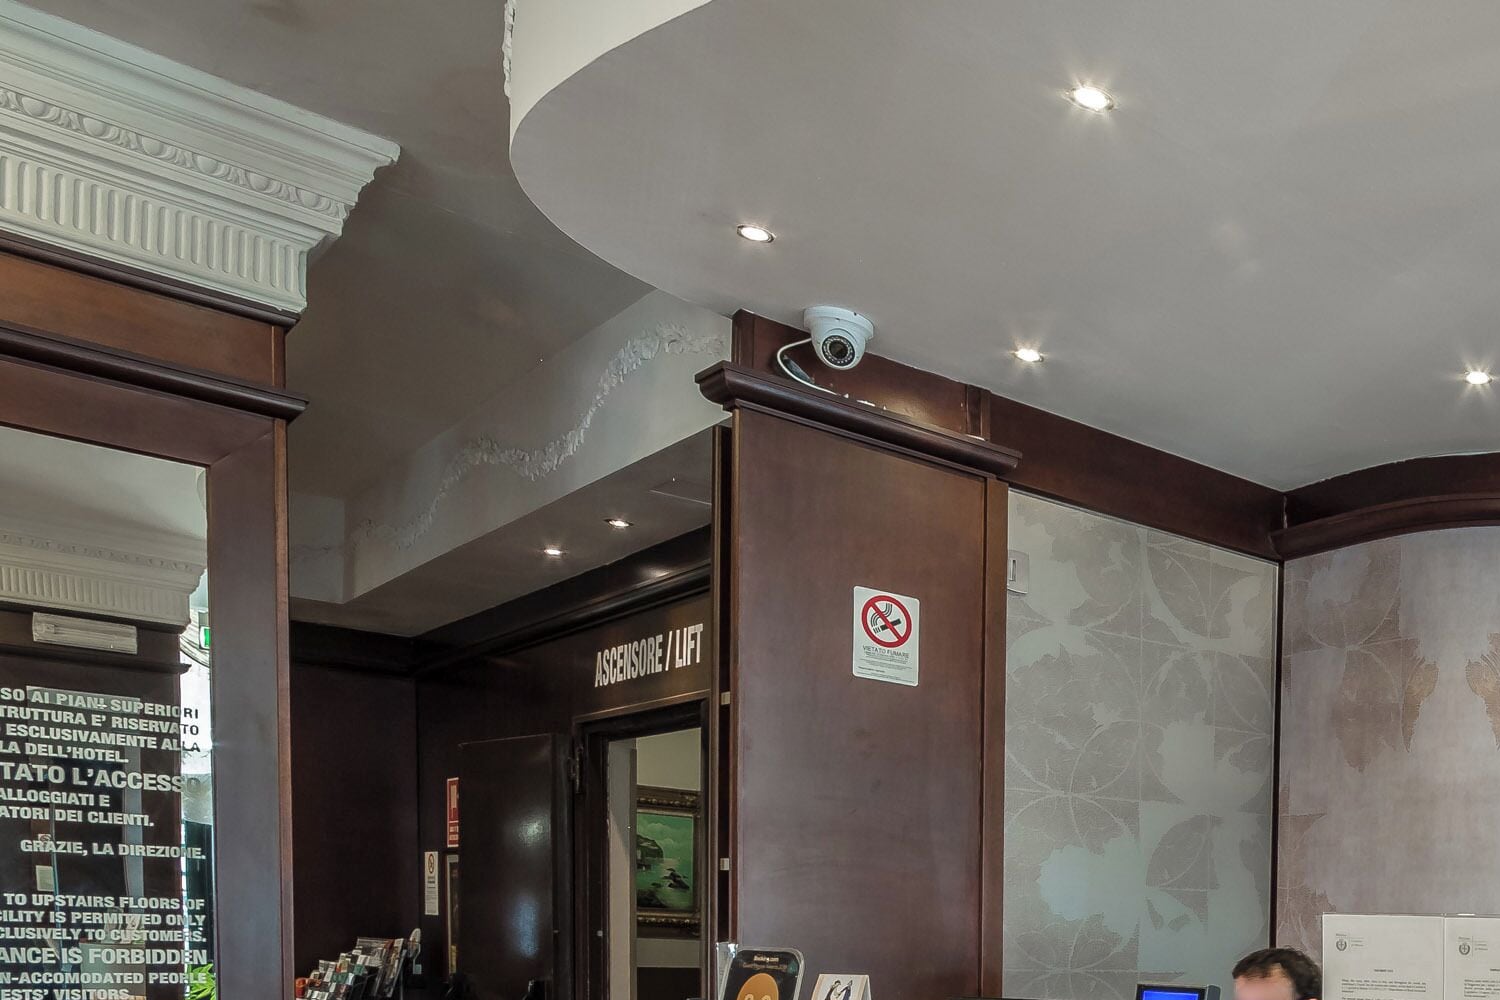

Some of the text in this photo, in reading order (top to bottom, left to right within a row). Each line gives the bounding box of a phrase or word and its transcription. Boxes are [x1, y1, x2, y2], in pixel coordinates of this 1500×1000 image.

[595, 623, 703, 687] ASCENSORE / LIFT
[31, 691, 49, 705] AI
[56, 693, 105, 710] PIANI
[110, 699, 200, 719] SUPERIORI
[112, 716, 199, 736] RISERVATO
[6, 723, 201, 753] ESCLUSIVAMENTE ALLA
[0, 762, 65, 784] TATO
[100, 795, 110, 807] E
[55, 809, 83, 823] DEI
[87, 811, 154, 827] CLIENTI.
[20, 839, 206, 860] GRAZIE, LA DIREZIONE.
[3, 893, 205, 910] TO UPSTAIRS FLOORS OF
[0, 910, 206, 927] ILITY IS PERMITTED ONLY
[85, 929, 105, 941] TO
[62, 948, 82, 965] IS
[89, 948, 207, 965] FORBIDDEN
[149, 972, 206, 985] PEOPLE
